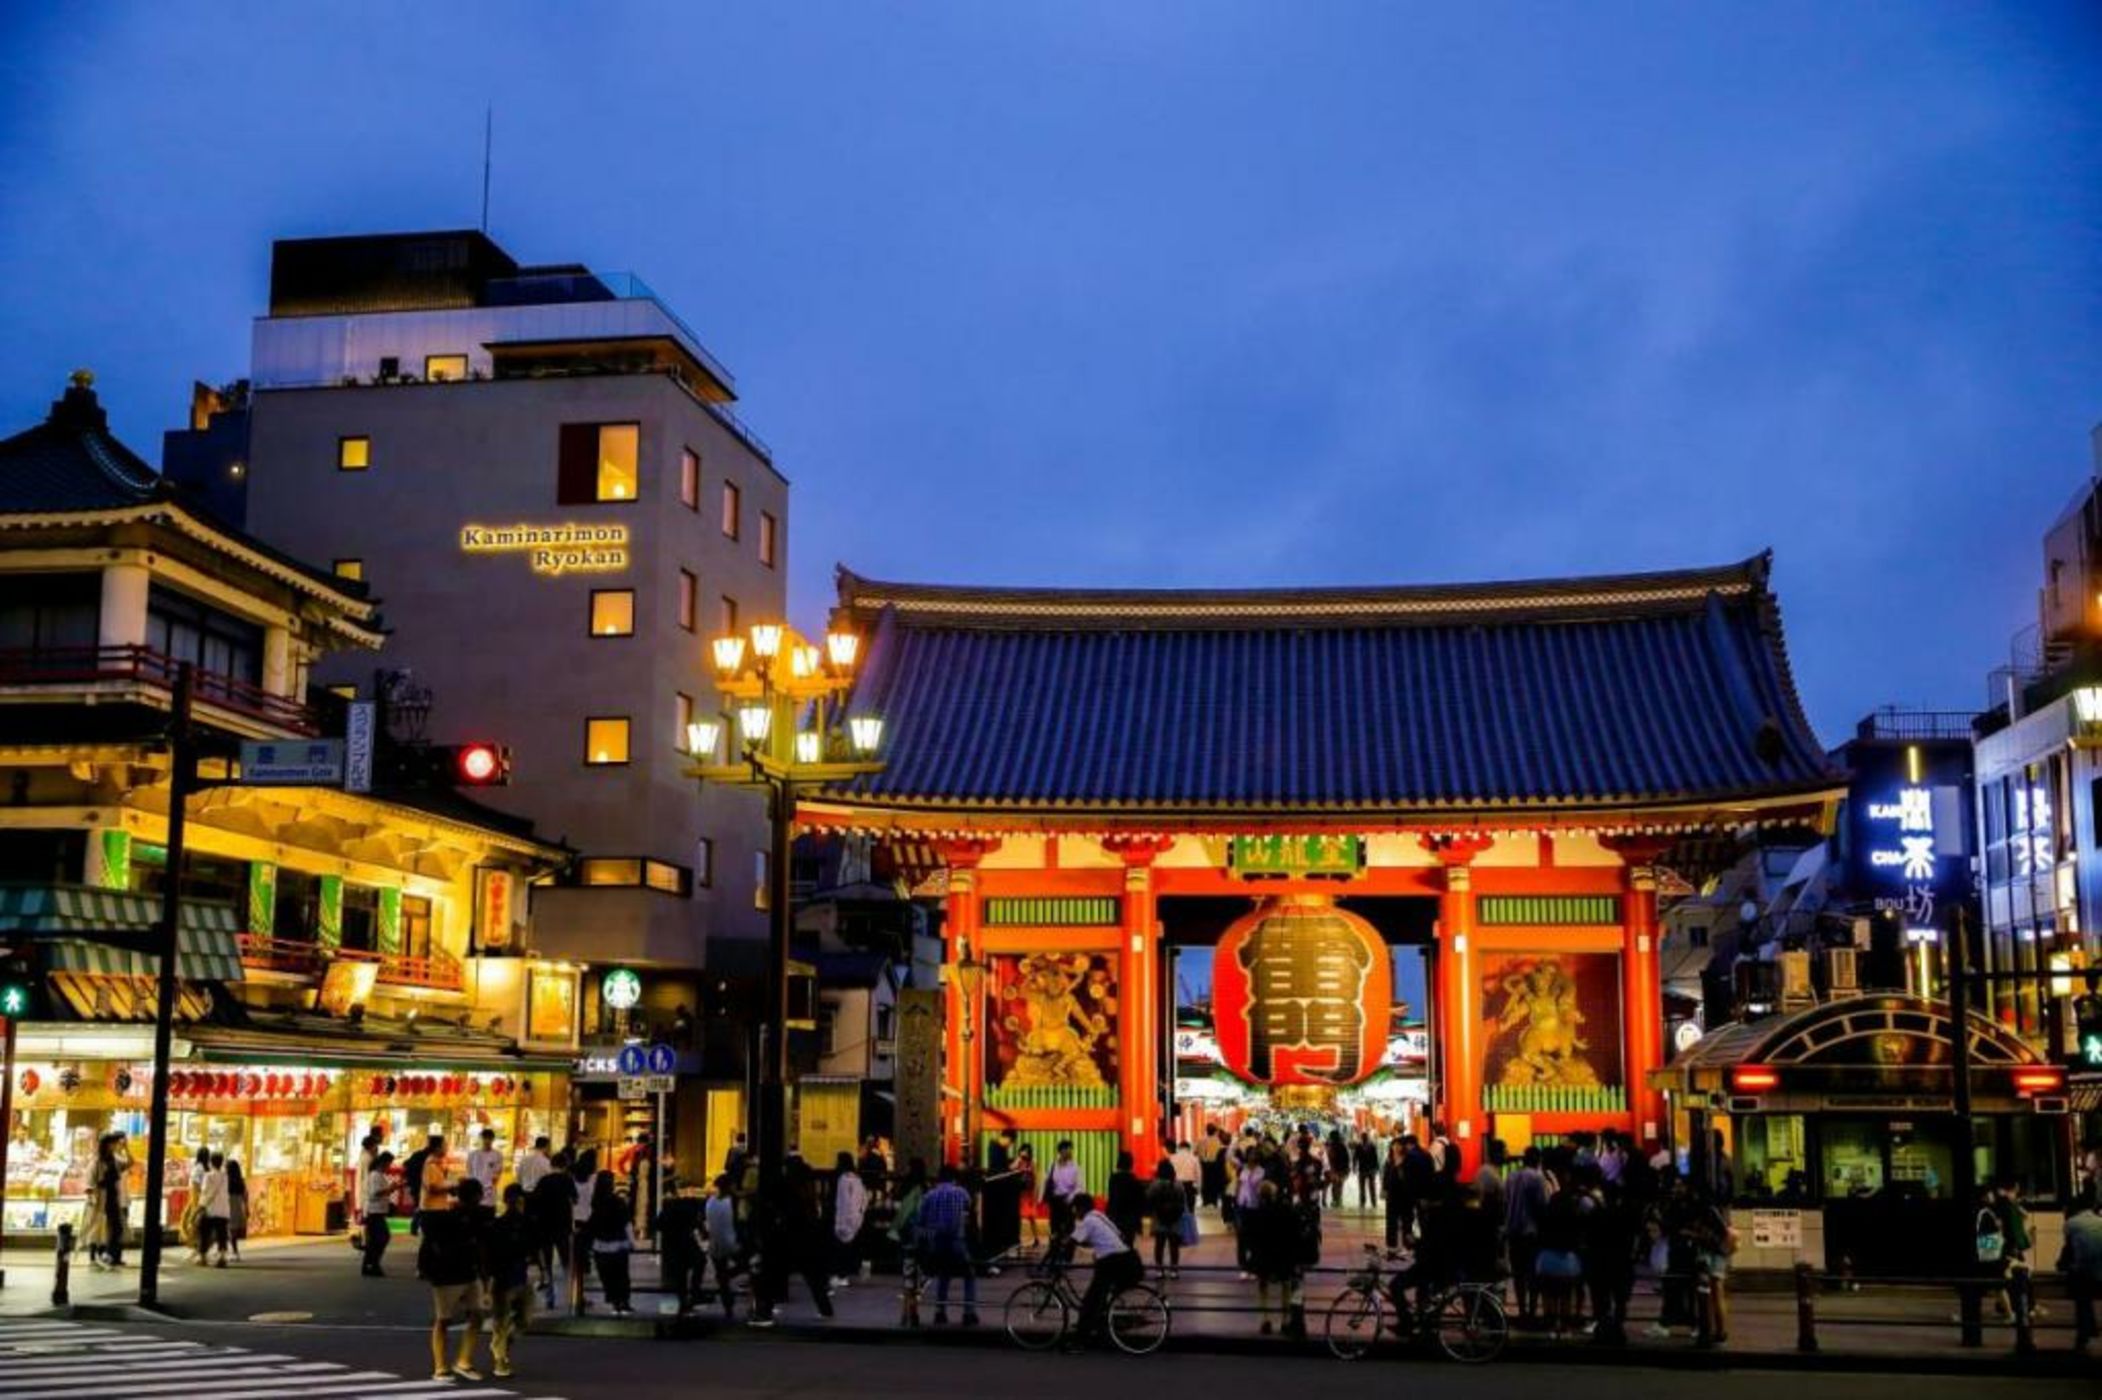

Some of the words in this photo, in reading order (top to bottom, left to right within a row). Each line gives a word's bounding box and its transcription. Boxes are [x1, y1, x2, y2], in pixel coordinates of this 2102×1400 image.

[463, 526, 623, 546] Kaminarimon
[535, 550, 622, 570] Ryokan
[1237, 916, 1374, 1083] 雷門
